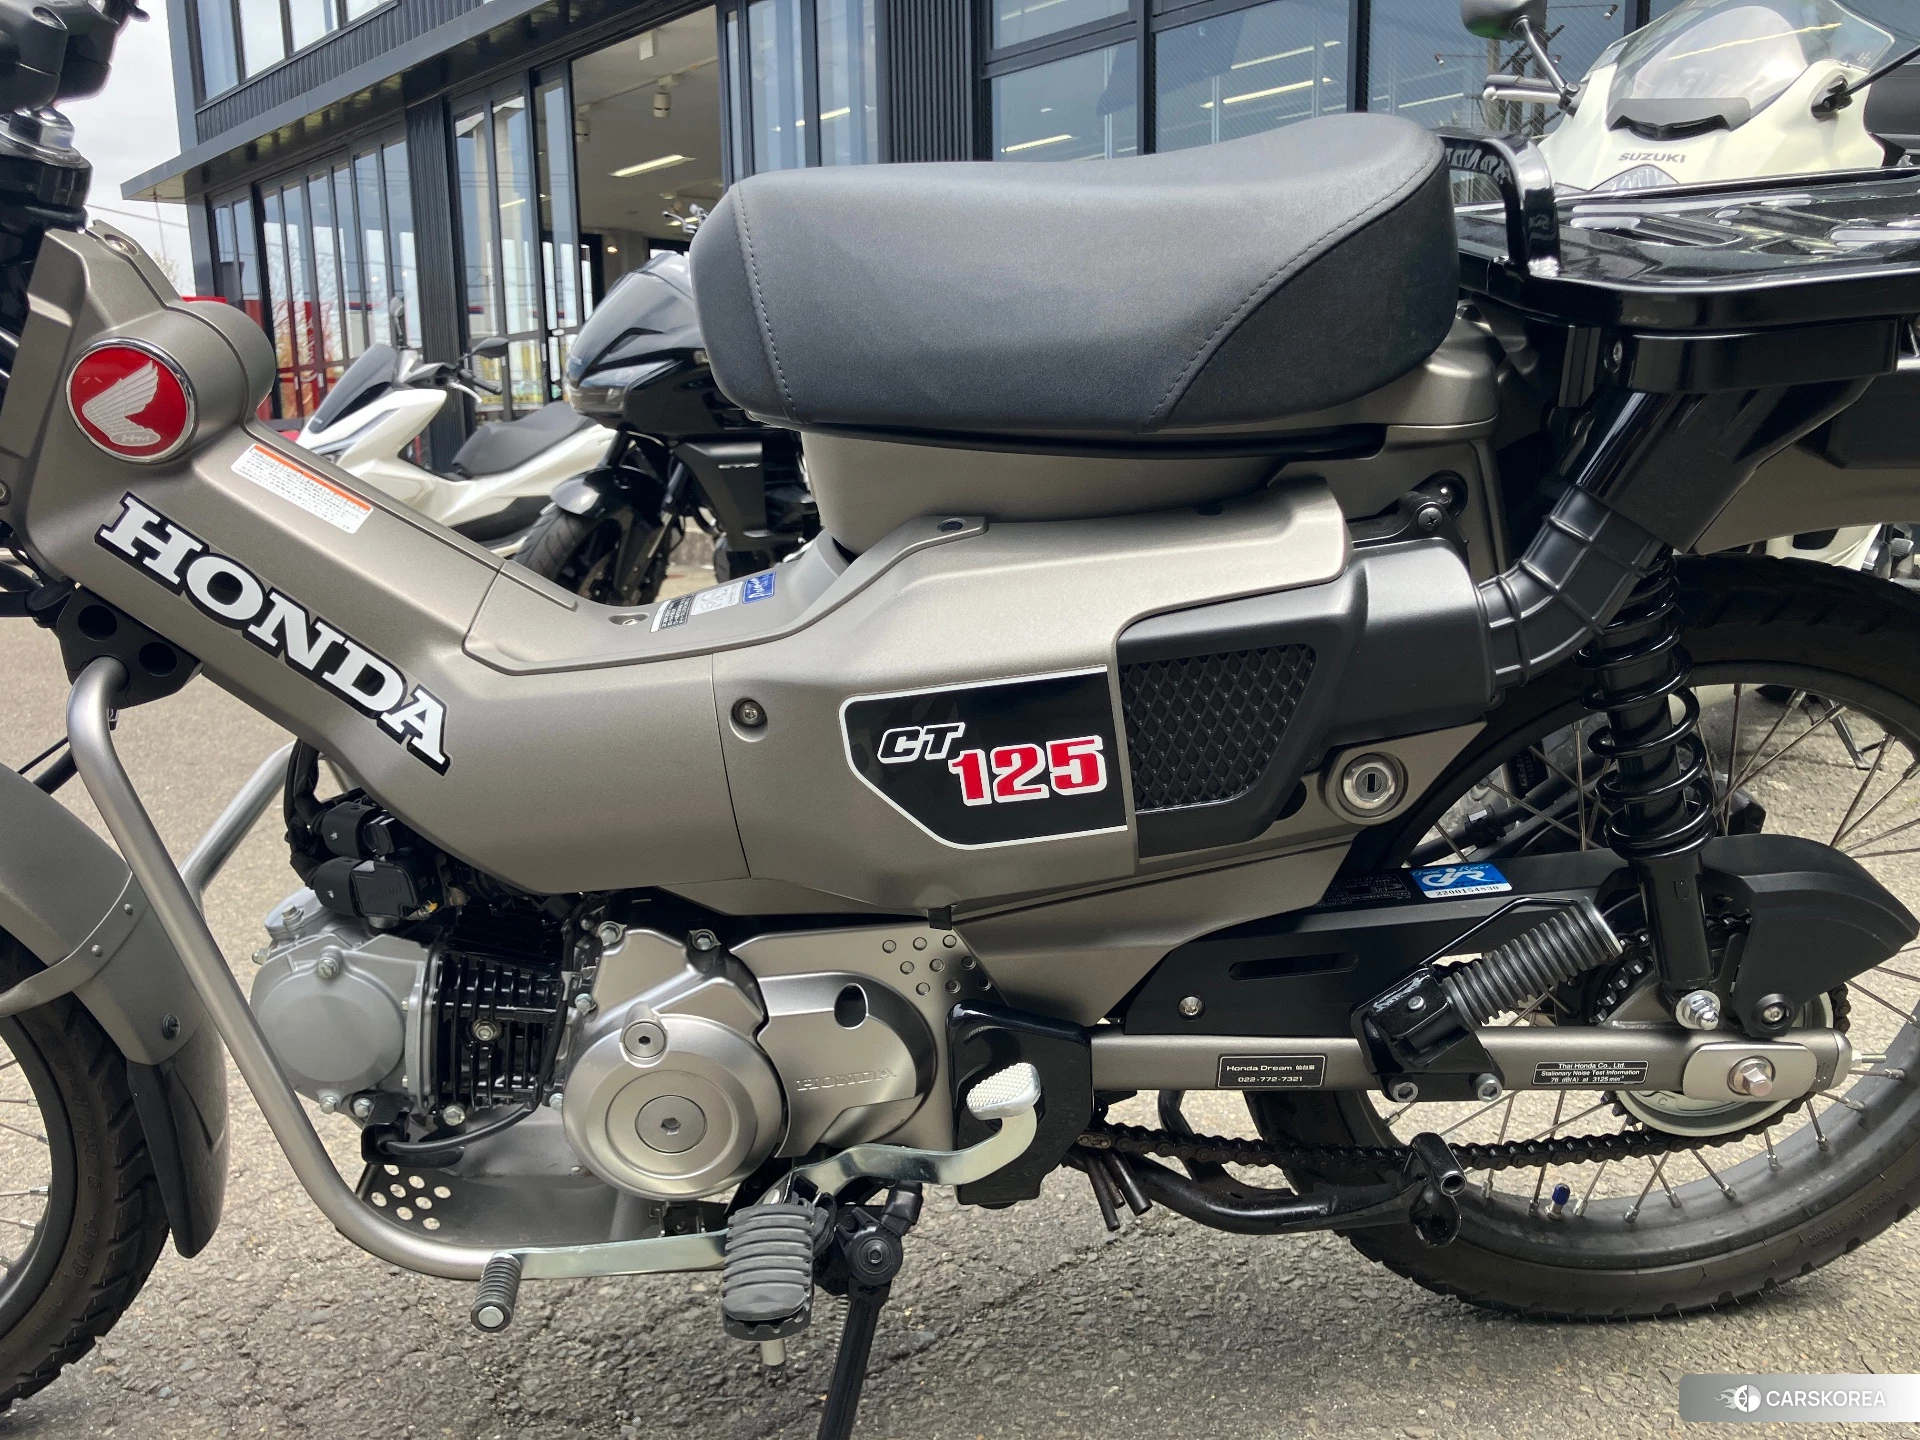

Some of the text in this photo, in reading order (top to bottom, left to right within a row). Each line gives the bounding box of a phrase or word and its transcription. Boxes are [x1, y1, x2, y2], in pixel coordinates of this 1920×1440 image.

[1617, 152, 1686, 163] SUZUKI
[96, 491, 450, 774] HONDA
[877, 722, 966, 764] CT
[948, 735, 1107, 806] 125
[797, 1068, 897, 1092] HONDA
